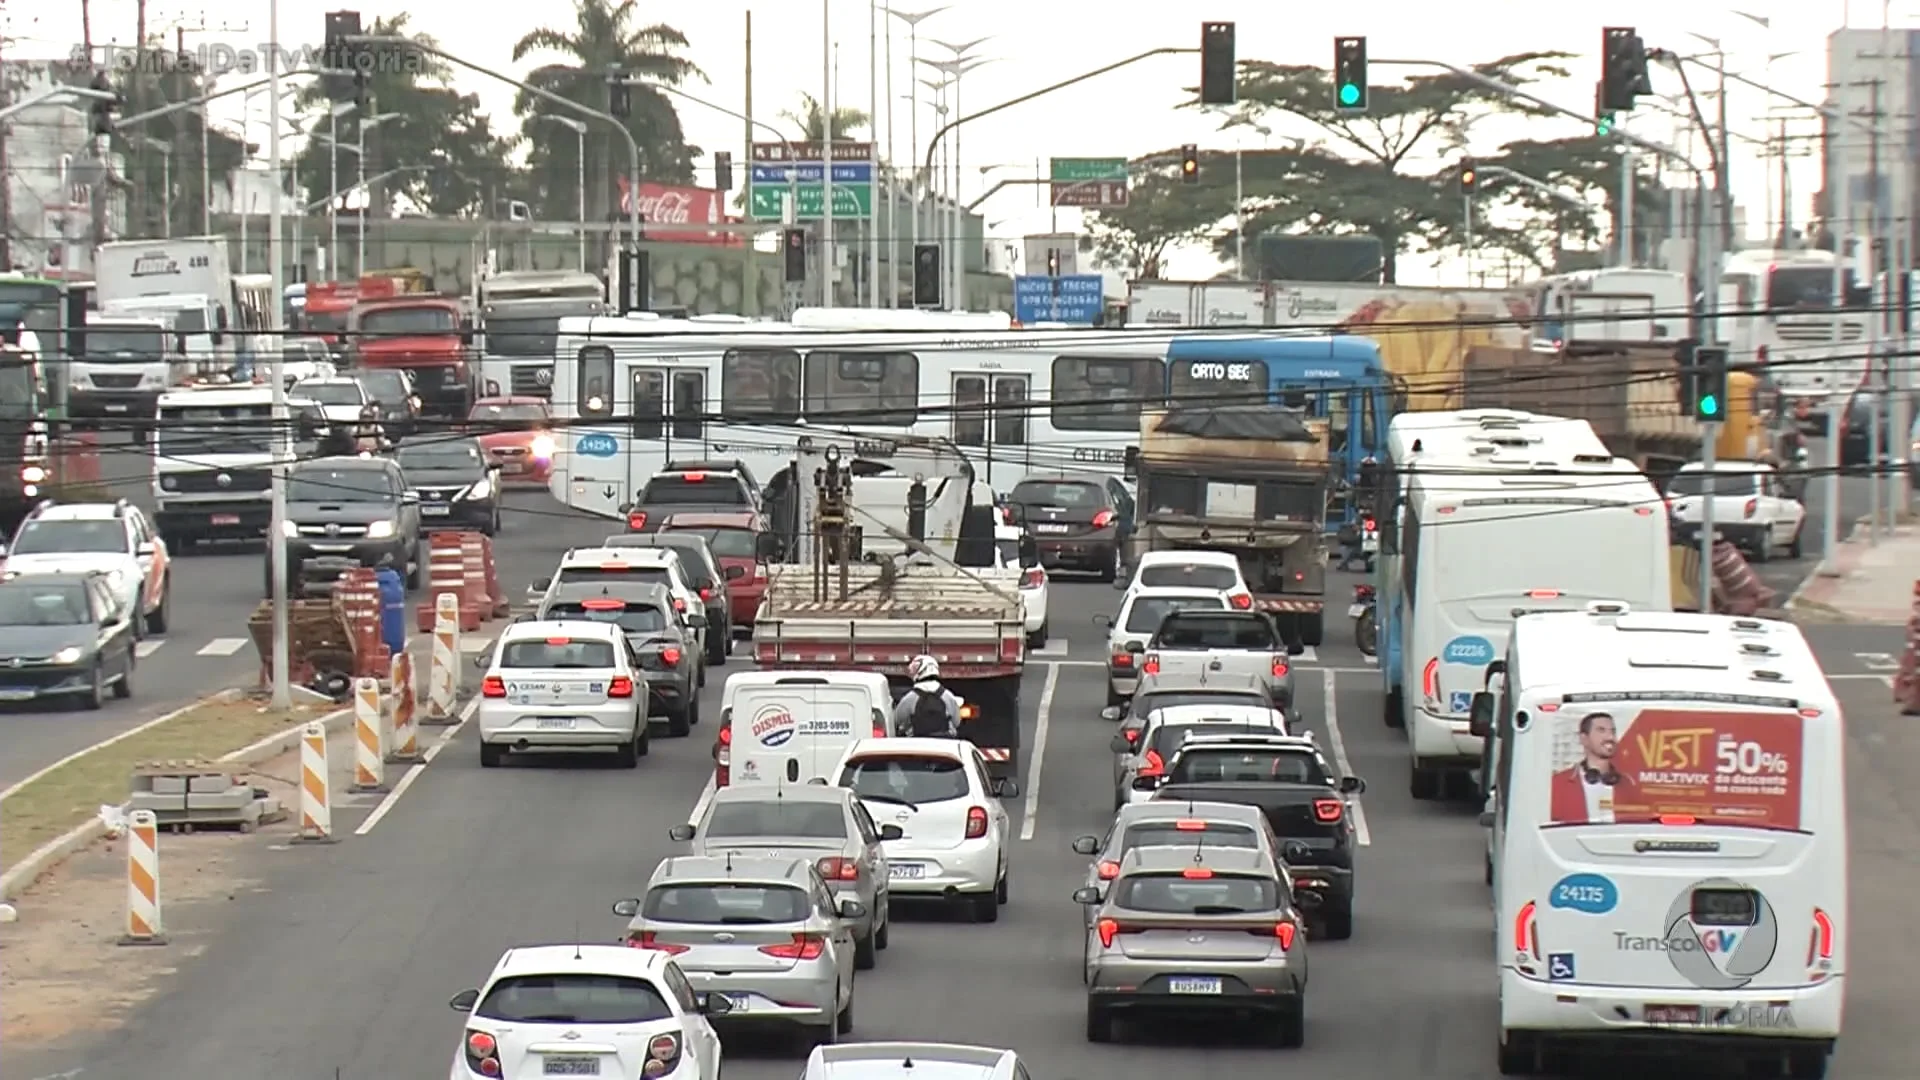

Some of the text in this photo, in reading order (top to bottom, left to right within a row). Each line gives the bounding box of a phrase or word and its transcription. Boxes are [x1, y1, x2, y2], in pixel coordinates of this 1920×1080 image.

[1191, 363, 1225, 379] ORTO
[752, 713, 795, 737] DISMIL
[1637, 728, 1715, 769] VEST
[1715, 742, 1788, 774] 50%
[1640, 772, 1710, 784] MULTIVIX
[1559, 886, 1604, 901] 24175
